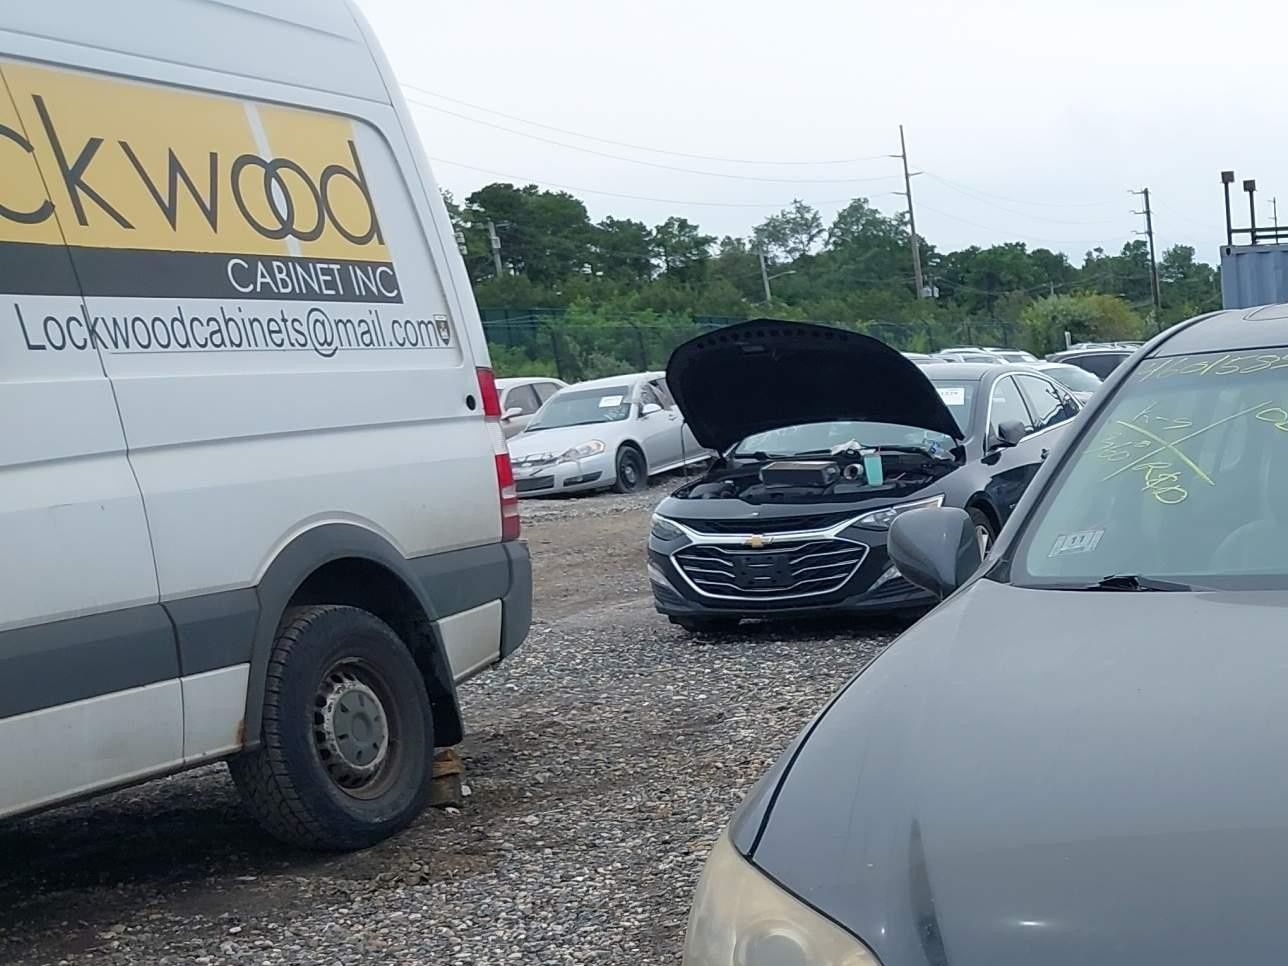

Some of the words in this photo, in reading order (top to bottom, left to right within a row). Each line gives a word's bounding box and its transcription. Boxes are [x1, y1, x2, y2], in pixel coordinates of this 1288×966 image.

[227, 258, 344, 295] CABINET
[348, 264, 399, 297] INC
[14, 303, 438, 357] Lockwoodcabinets@mail.com
